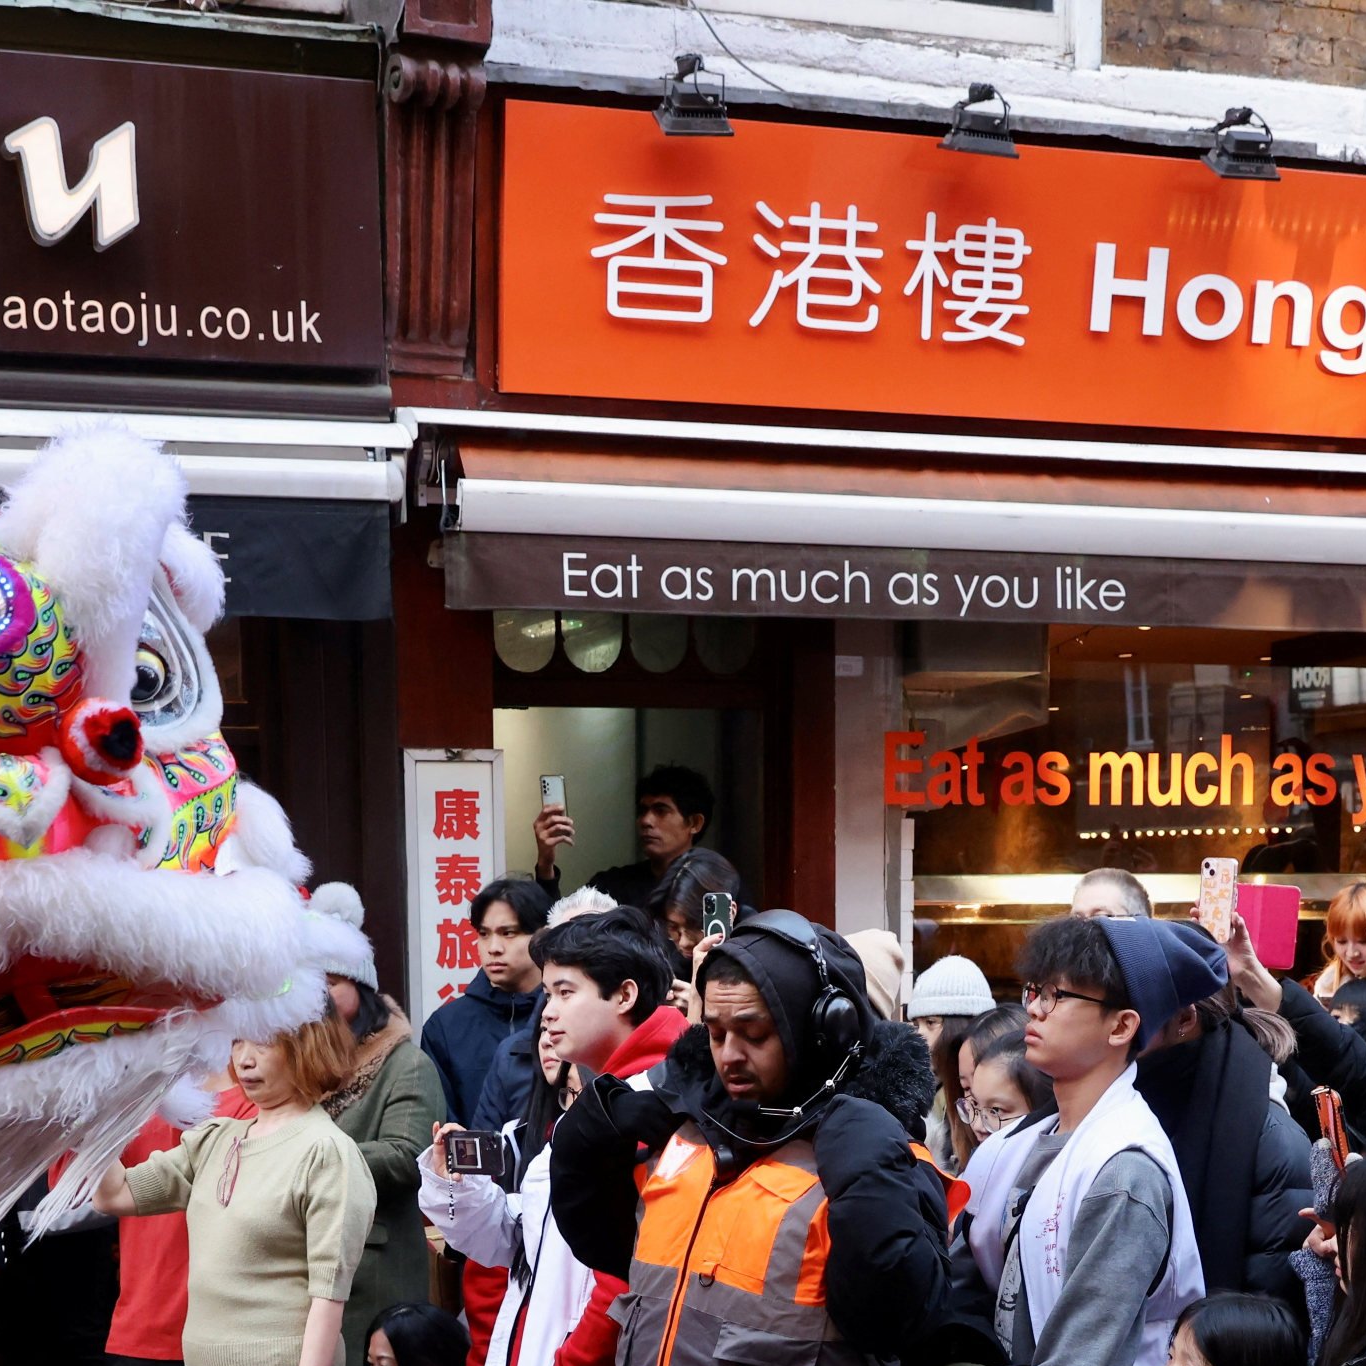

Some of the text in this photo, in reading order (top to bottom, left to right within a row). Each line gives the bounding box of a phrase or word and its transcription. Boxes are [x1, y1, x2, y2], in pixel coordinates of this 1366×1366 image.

[590, 193, 1033, 346] 香港樓
[561, 552, 1127, 617] Eat as much as you like
[885, 731, 984, 806] Eat
[1000, 751, 1071, 806] as
[1088, 734, 1255, 807] much
[1270, 753, 1336, 807] as
